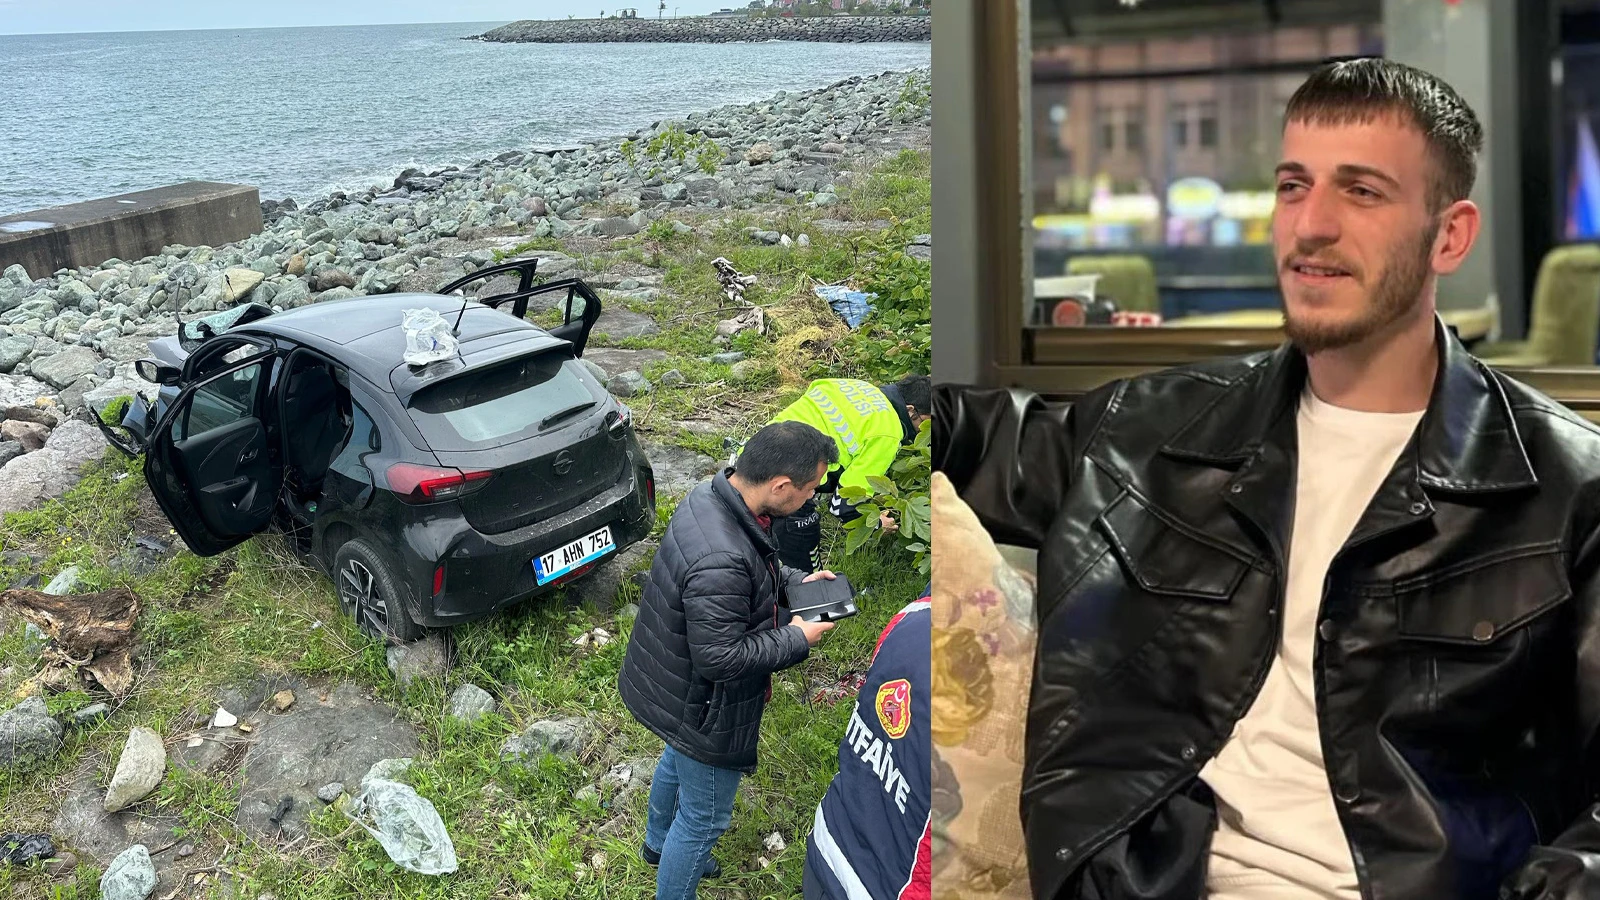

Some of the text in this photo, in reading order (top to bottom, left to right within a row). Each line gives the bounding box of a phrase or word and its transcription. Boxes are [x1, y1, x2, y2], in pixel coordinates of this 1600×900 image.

[542, 529, 610, 574] 17 AHN 752
